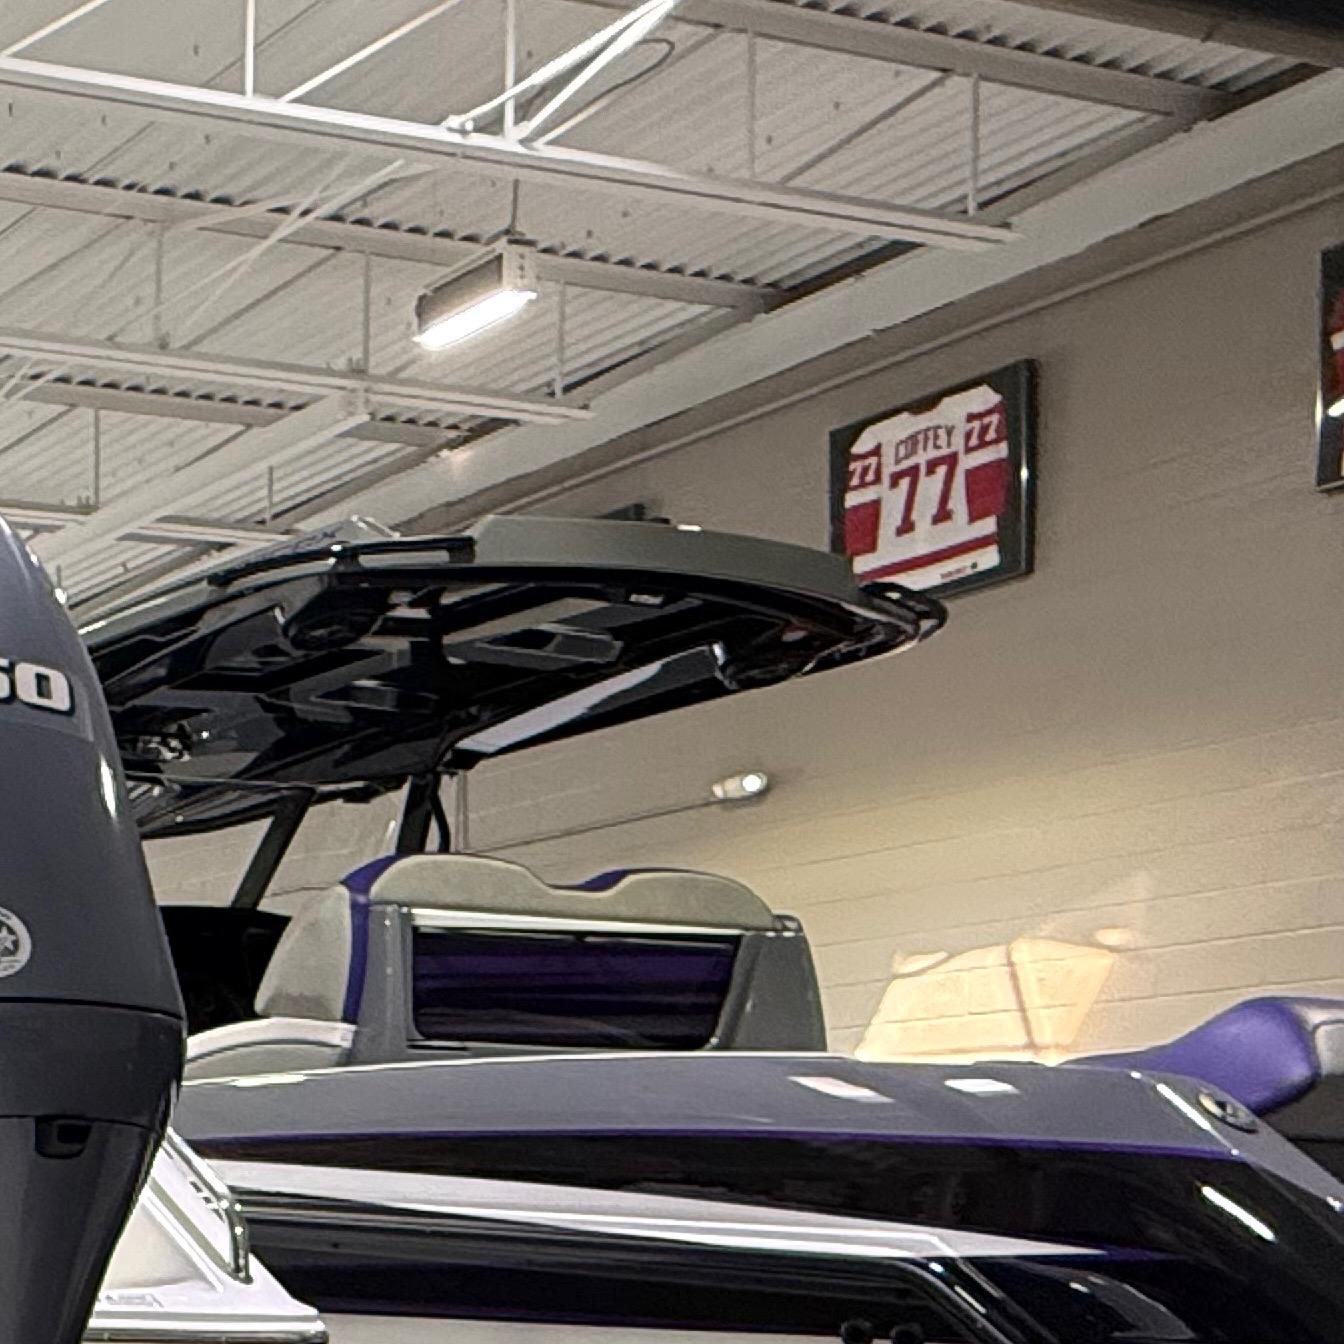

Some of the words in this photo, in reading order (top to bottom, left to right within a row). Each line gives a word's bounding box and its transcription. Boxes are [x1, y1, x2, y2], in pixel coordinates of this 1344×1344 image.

[967, 412, 1000, 448] 77
[848, 456, 879, 487] 77
[888, 451, 960, 538] 77
